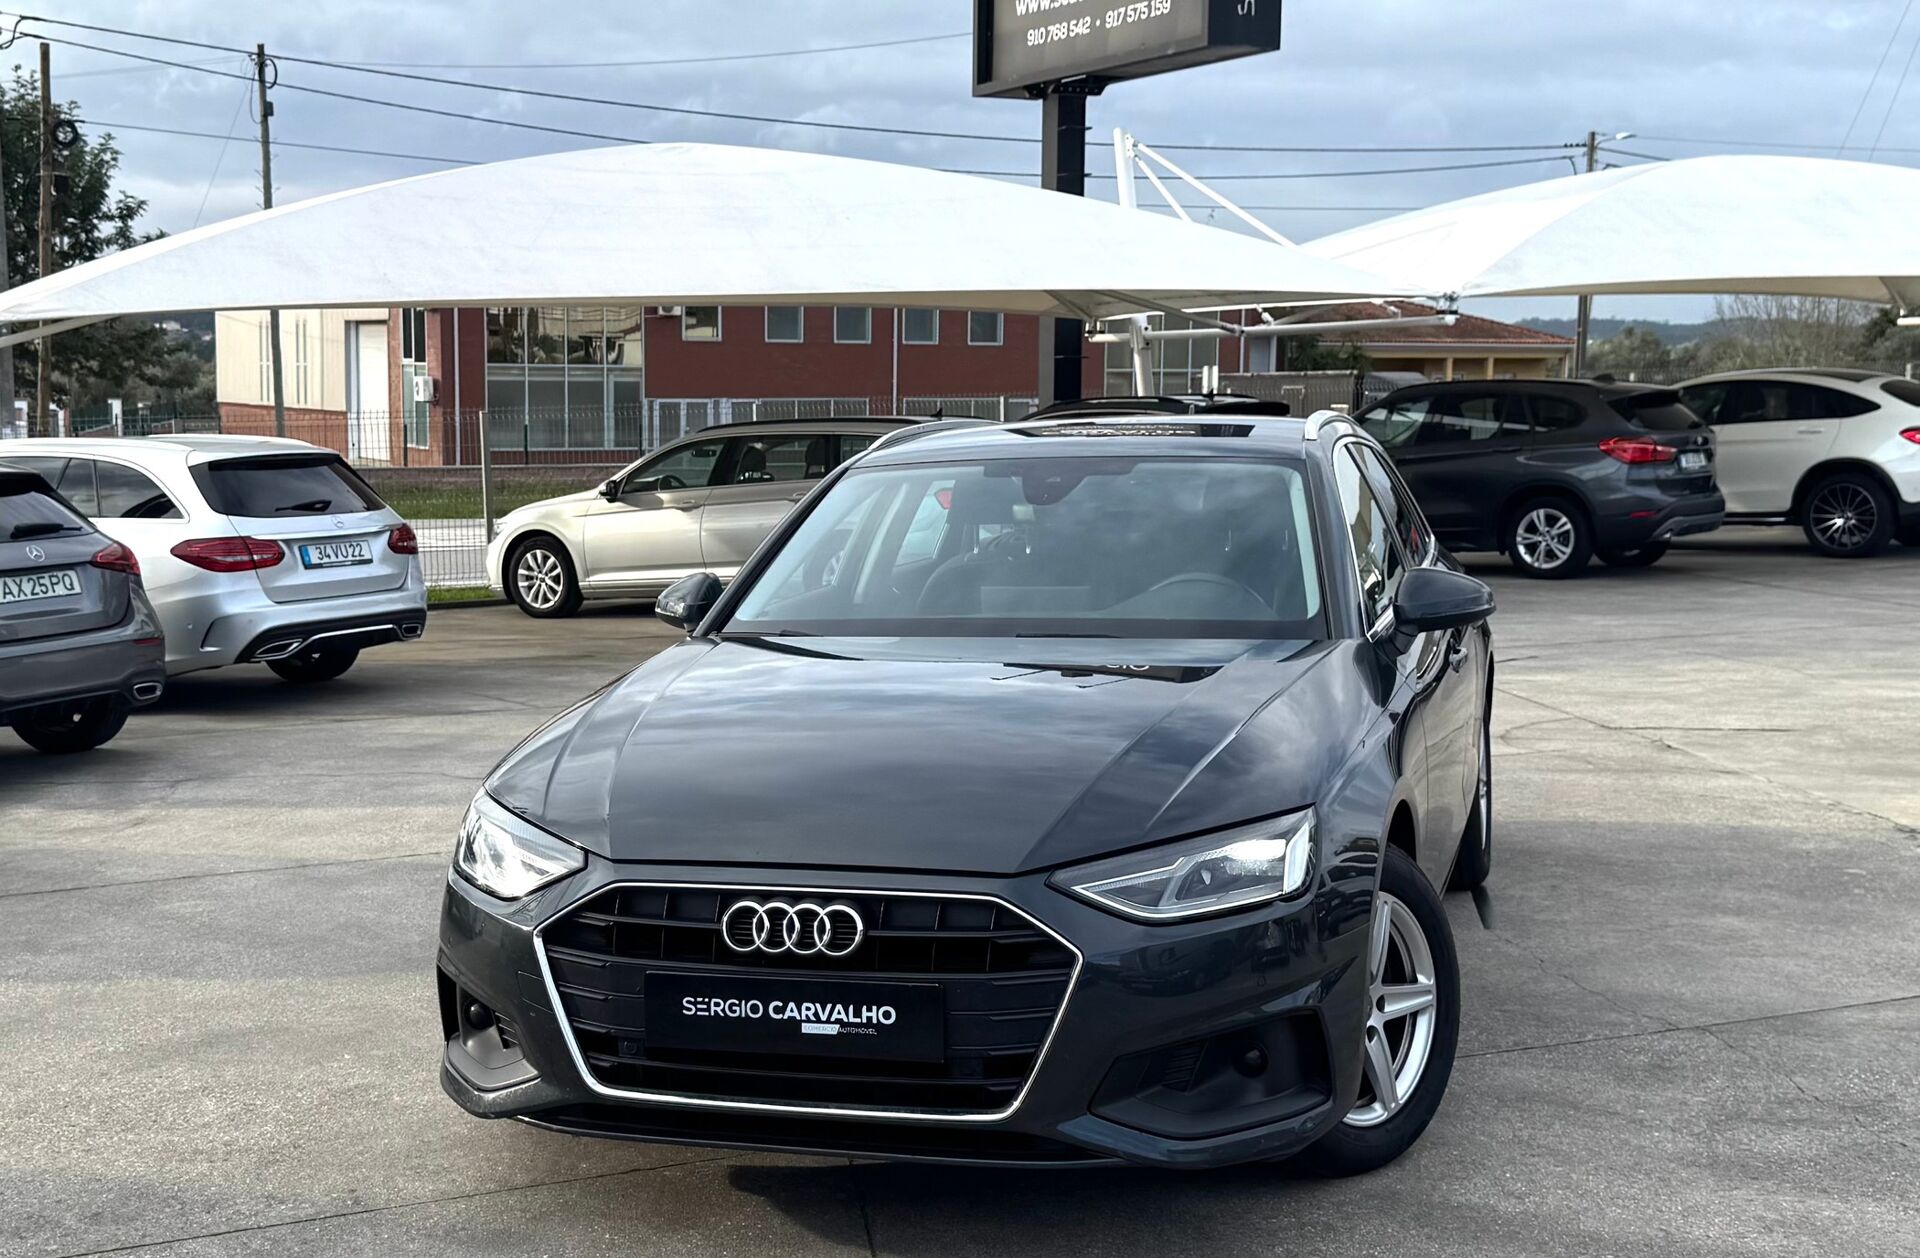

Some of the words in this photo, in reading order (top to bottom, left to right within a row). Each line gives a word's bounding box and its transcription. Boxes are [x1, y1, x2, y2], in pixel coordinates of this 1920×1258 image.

[1027, 27, 1046, 46] 910
[1047, 22, 1068, 43] 768
[1069, 16, 1091, 37] 542
[1105, 7, 1126, 29] 917
[1126, 1, 1148, 23] 575
[1150, 0, 1171, 17] 159
[2, 573, 75, 599] AX25PQ
[768, 1001, 896, 1024] CARVALHO
